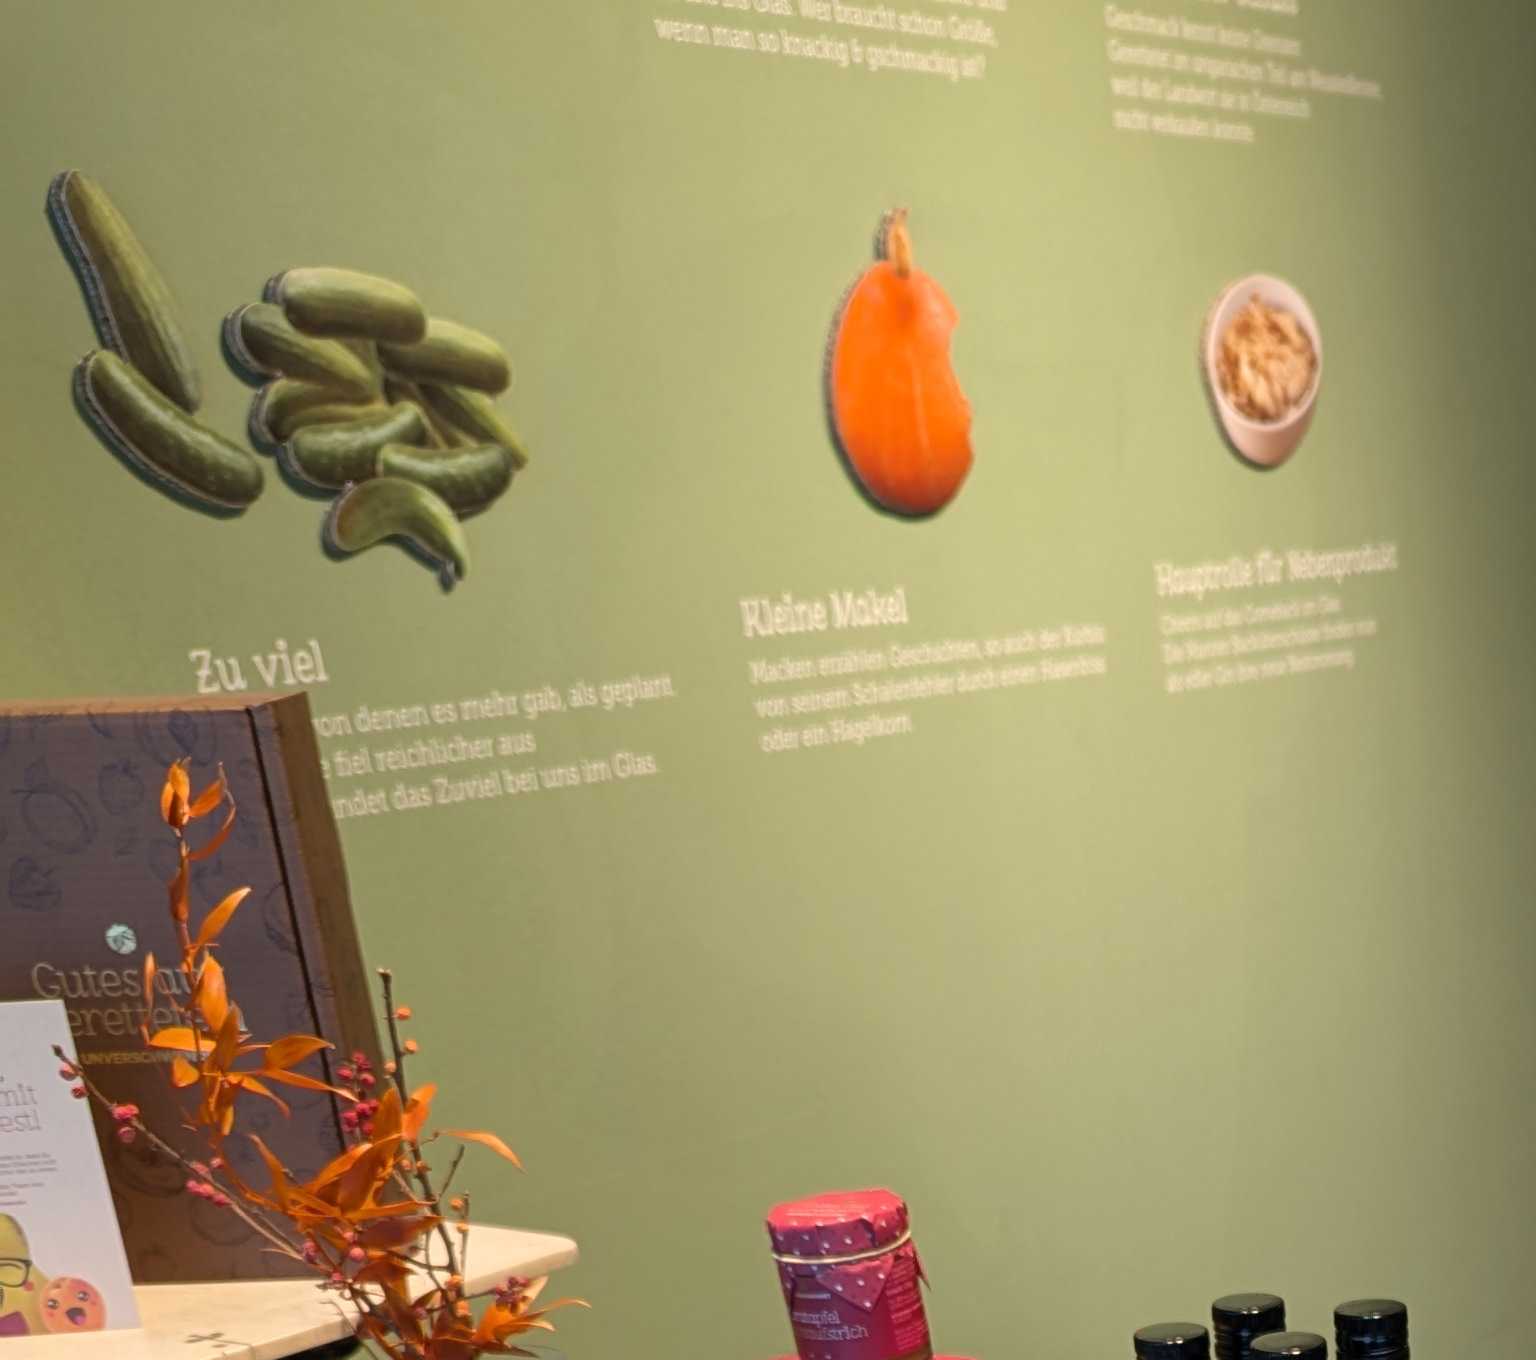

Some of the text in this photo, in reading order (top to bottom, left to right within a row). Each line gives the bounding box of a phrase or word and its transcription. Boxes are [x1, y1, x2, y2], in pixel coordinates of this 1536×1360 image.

[739, 585, 909, 638] Kleine Makel
[188, 638, 330, 695] Zu viel
[353, 703, 432, 733] denen
[431, 700, 459, 725] es
[458, 687, 519, 721] mehr
[567, 677, 598, 708] als
[496, 730, 537, 756] aus
[390, 781, 433, 811] das
[433, 770, 503, 805] Zuviel
[502, 766, 540, 795] bei
[539, 764, 582, 790] uns
[31, 962, 139, 998] Gutes
